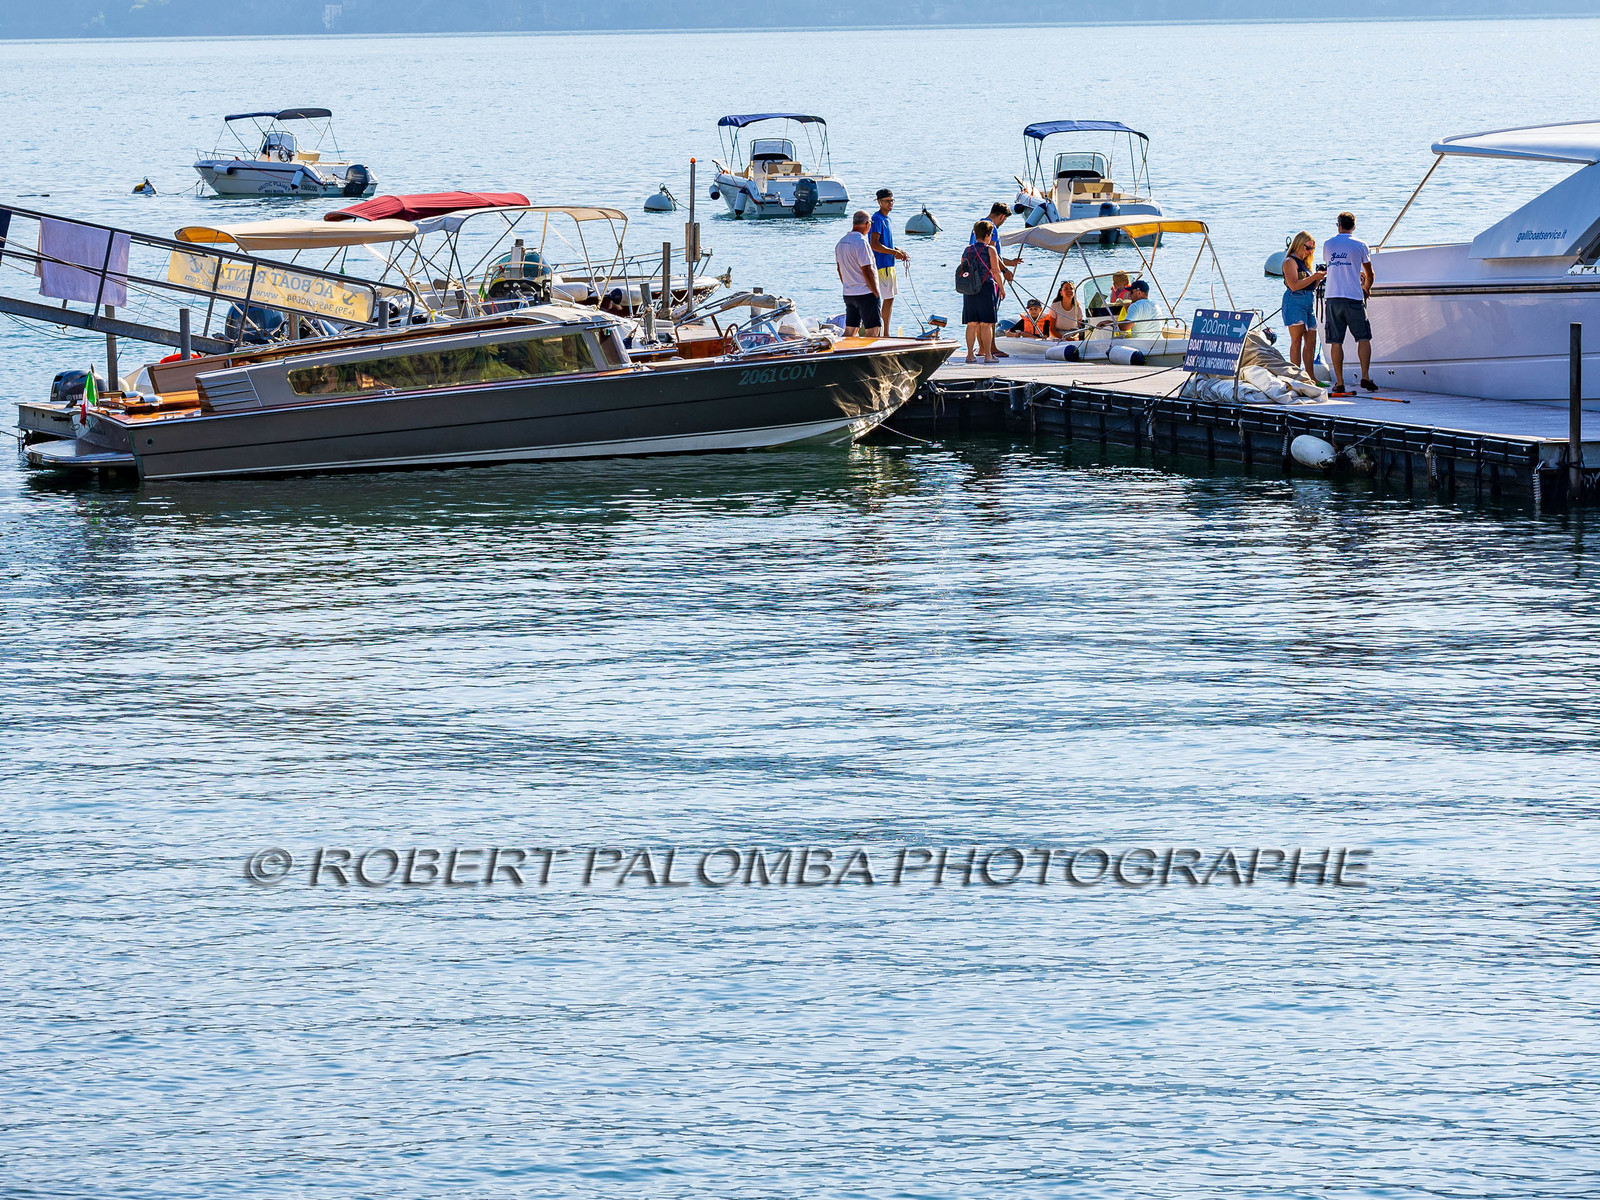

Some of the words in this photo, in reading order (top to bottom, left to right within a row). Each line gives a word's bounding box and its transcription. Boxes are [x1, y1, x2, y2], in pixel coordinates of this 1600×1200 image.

[1515, 229, 1568, 243] galliboatservice.it
[1200, 318, 1231, 336] 200mt
[1188, 338, 1203, 351] BOAT
[1203, 340, 1218, 353] TOUR
[1217, 341, 1223, 353] &
[1185, 355, 1197, 367] ASK
[1195, 356, 1206, 368] FOR
